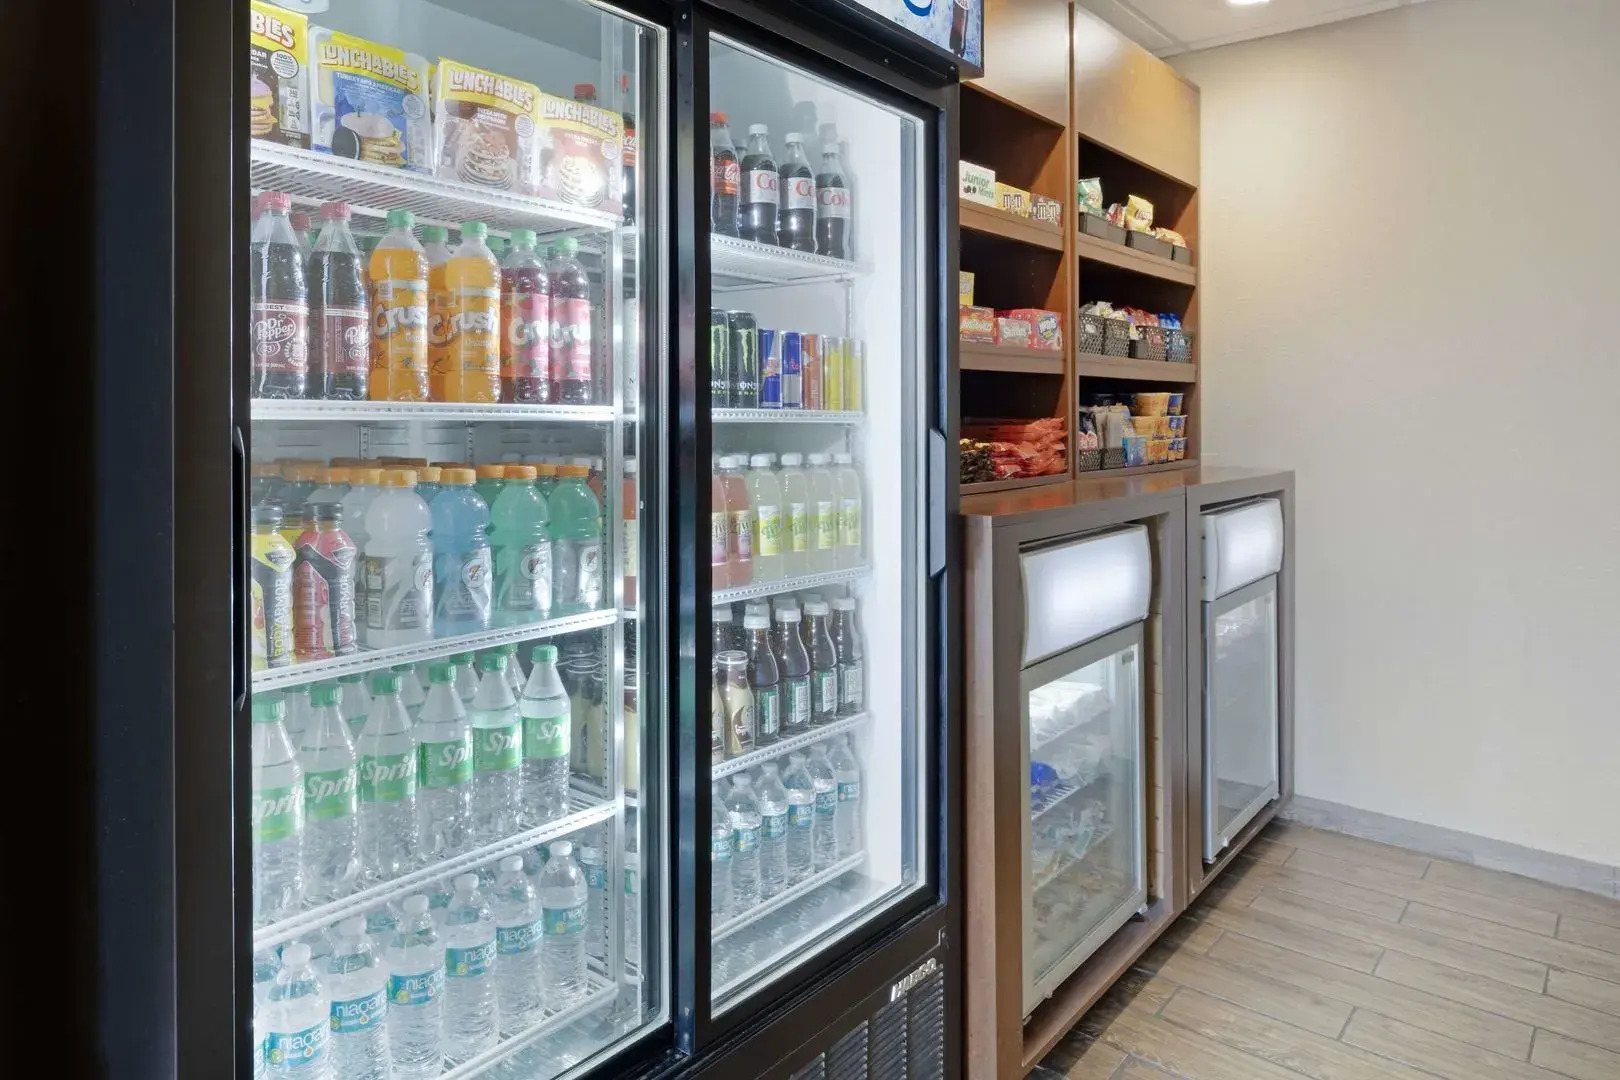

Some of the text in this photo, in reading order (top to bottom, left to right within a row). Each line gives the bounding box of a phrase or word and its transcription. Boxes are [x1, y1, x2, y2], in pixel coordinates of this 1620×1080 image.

[250, 9, 296, 49] BLES
[319, 42, 420, 92] LUNCHABLES
[449, 69, 535, 113] LUNCHABLES
[543, 98, 617, 137] LUNCHABLES
[962, 170, 990, 189] Junior
[256, 320, 294, 341] Pepper
